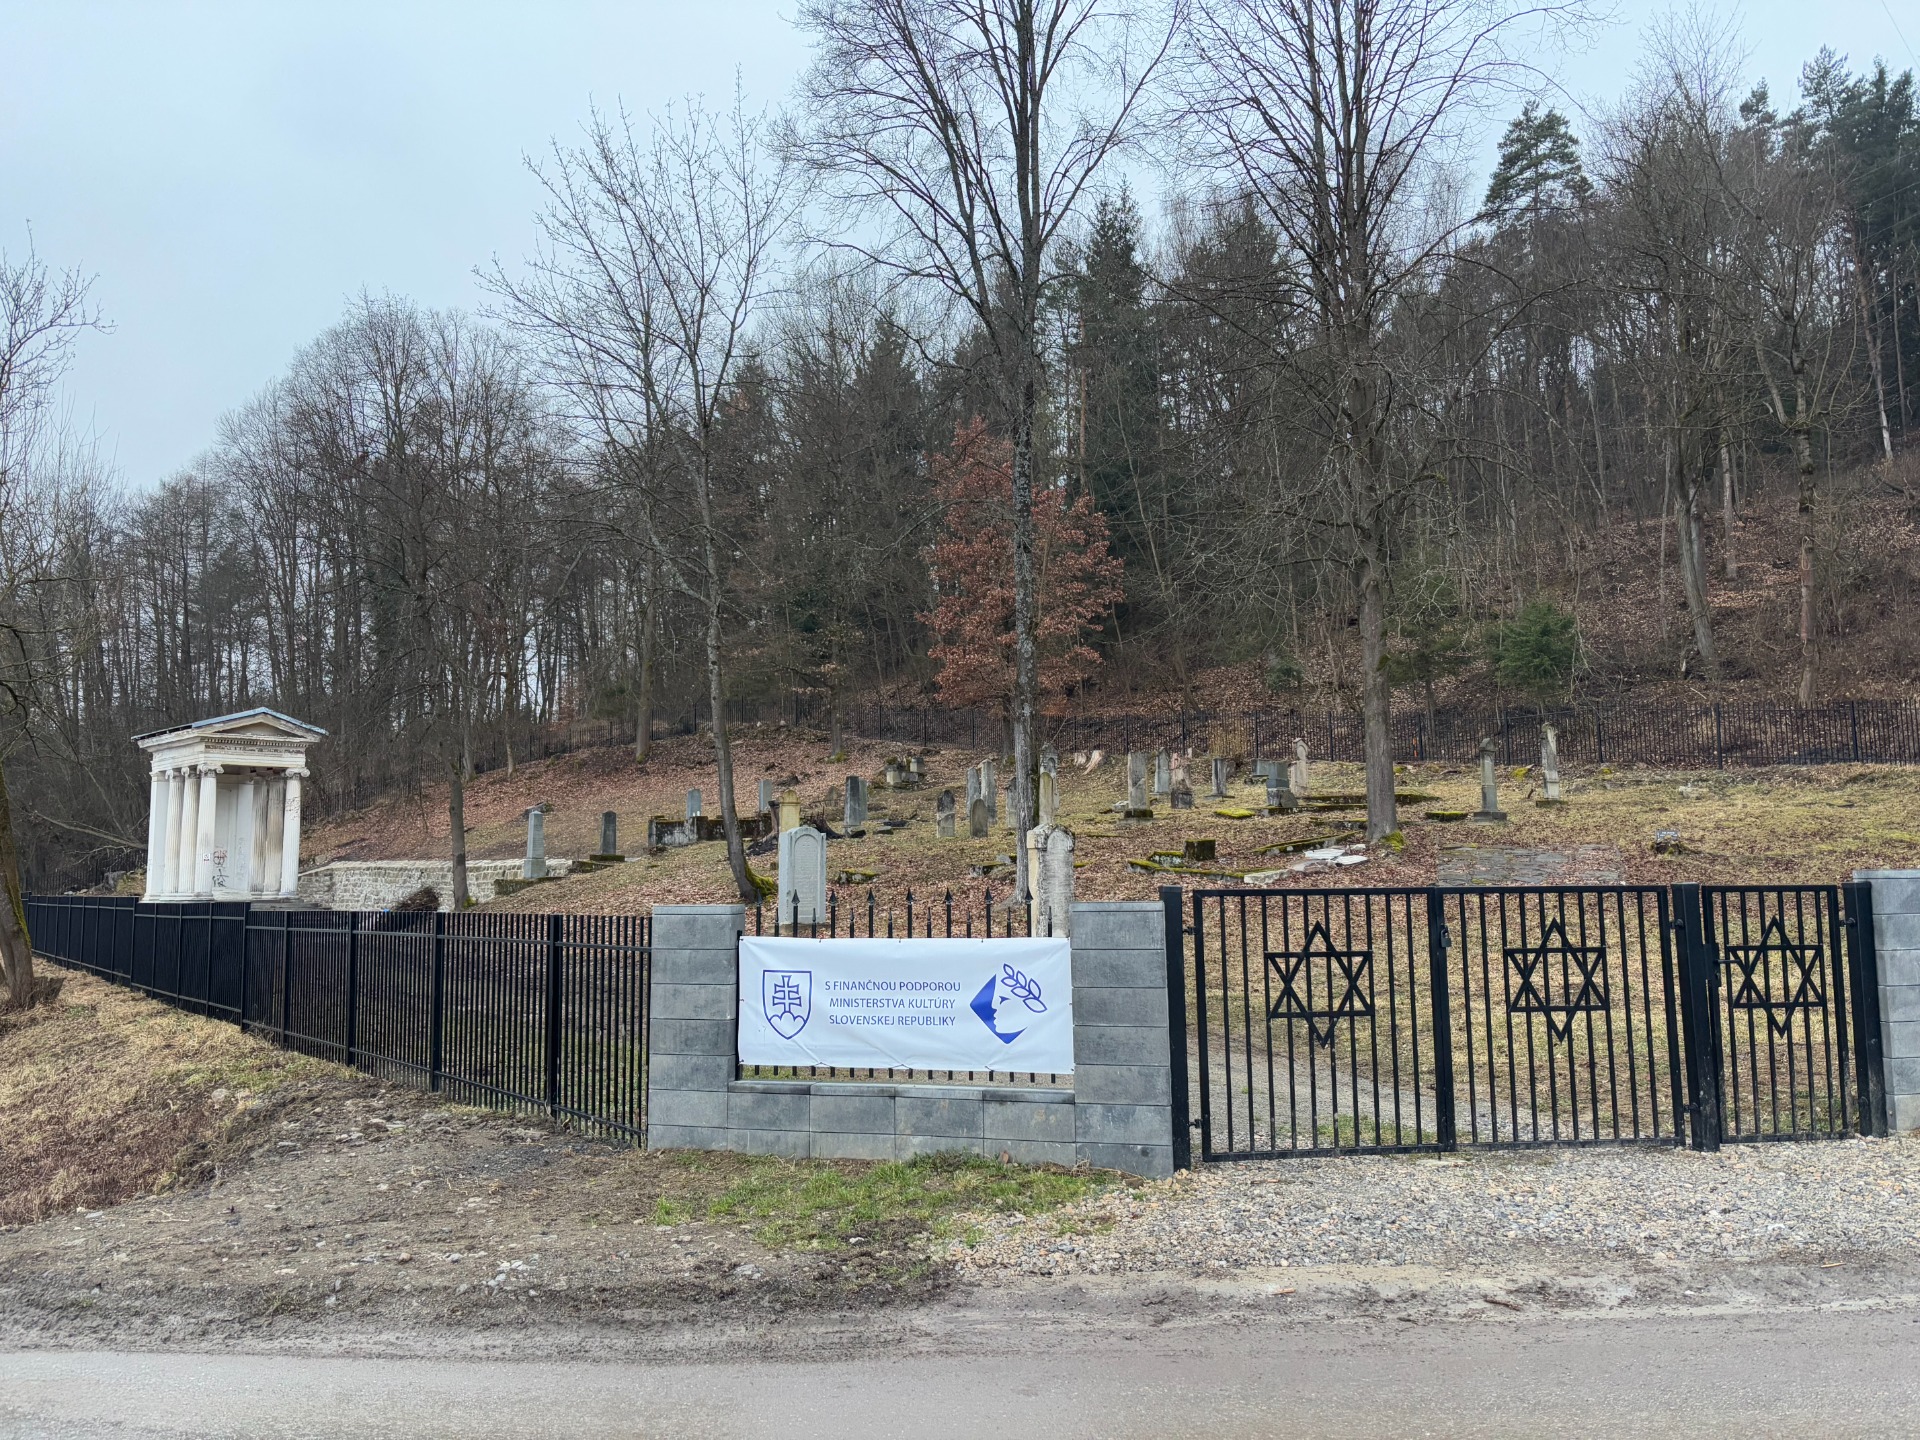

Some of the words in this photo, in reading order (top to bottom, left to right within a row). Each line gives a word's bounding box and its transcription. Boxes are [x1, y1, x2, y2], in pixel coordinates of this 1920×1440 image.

[825, 981, 831, 991] S
[833, 979, 896, 991] FINANČNOU
[899, 981, 961, 992] PODPOROU
[829, 998, 905, 1009] MINISTERSTVA
[908, 997, 956, 1009] KULTÚRY
[829, 1014, 895, 1026] SLOVENSKEJ
[897, 1015, 956, 1026] REPUBLIKY
